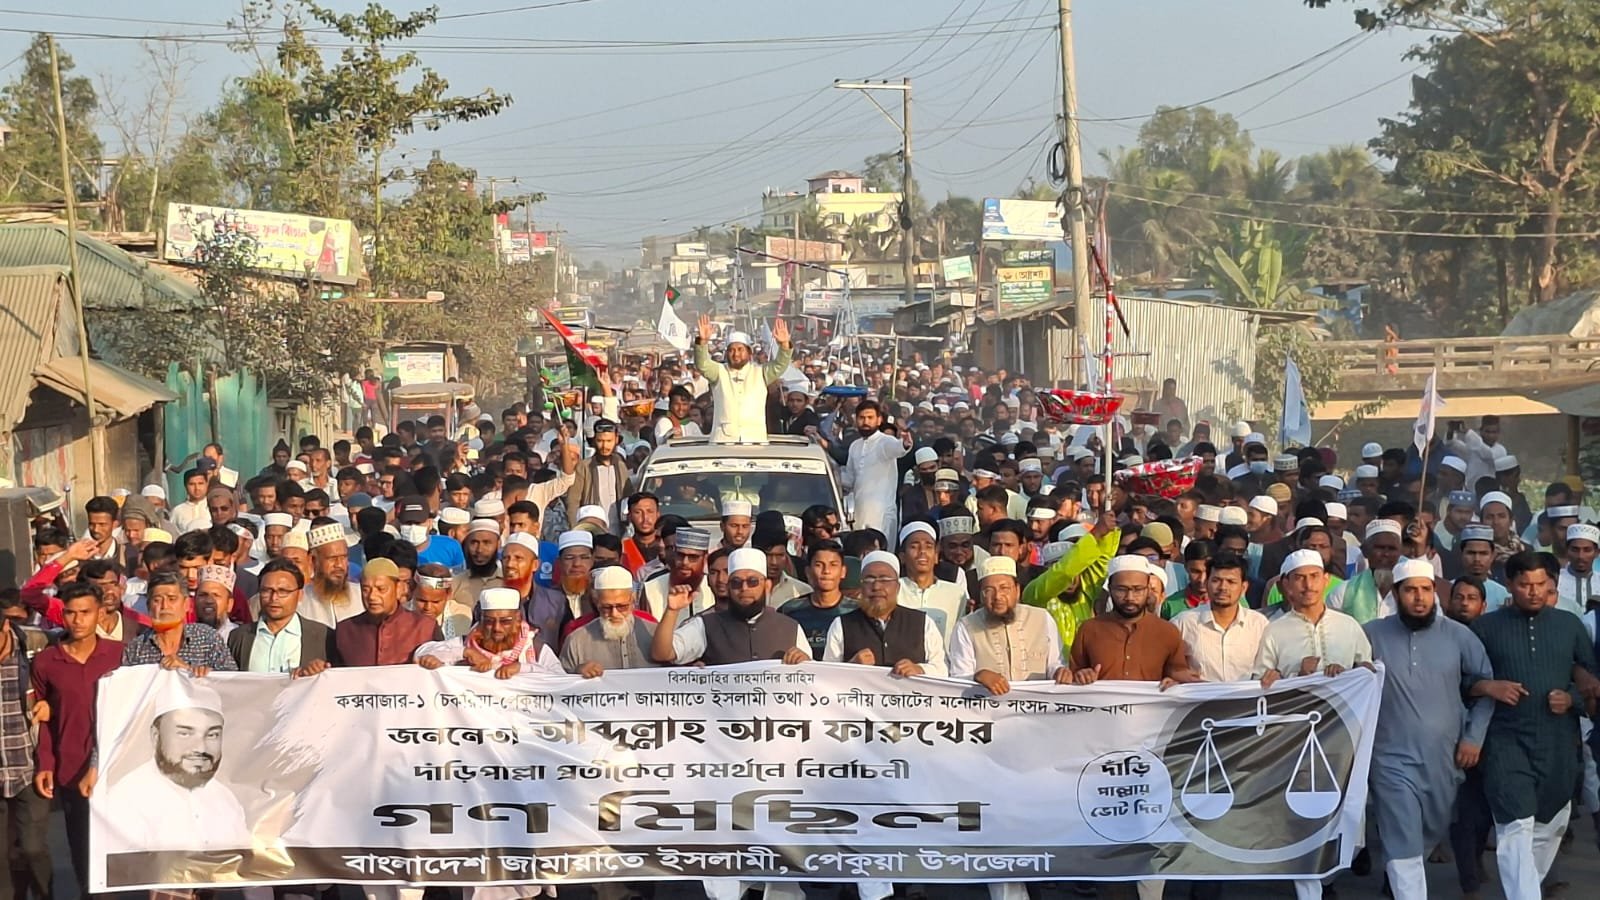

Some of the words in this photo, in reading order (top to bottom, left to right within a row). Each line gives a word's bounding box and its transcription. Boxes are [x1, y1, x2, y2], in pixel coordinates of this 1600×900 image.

[668, 671, 729, 685] বিসমিল্লাহির
[733, 672, 781, 685] রাহমানির
[785, 671, 816, 685] রাহিম
[335, 692, 425, 710] কক্সবাজার-১
[561, 691, 628, 709] বাংলাদেশ
[635, 691, 704, 708] জামায়াতে
[711, 687, 767, 709] ইসলামী
[773, 692, 803, 707] তথা
[810, 693, 830, 708] ১০
[837, 687, 875, 709] দলীয়
[881, 690, 933, 709] জোটের
[1007, 700, 1049, 714] সংসদ
[386, 727, 519, 746] জননেতা
[528, 715, 707, 751] আব্দুল্লাহ
[716, 715, 812, 744] আল
[822, 716, 995, 746] ফারুখের
[413, 760, 546, 784] দাঁড়িপাল্লা
[556, 760, 675, 783] প্রতীকের
[684, 758, 786, 782] সমর্থনে
[796, 758, 911, 780] নির্বাচনী
[1100, 755, 1153, 778] দাঁড়ি
[1097, 784, 1150, 798] পাল্লায়
[373, 802, 556, 835] গণ
[589, 789, 990, 835] মিছিল
[1090, 801, 1128, 817] ভোট
[1133, 799, 1163, 815] দিন
[342, 852, 489, 876] বাংলাদেশ
[497, 851, 650, 880] জামায়াতে
[655, 845, 789, 874] ইসলামী,
[804, 849, 908, 877] পেকুয়া
[915, 847, 1056, 873] উপজেলা
